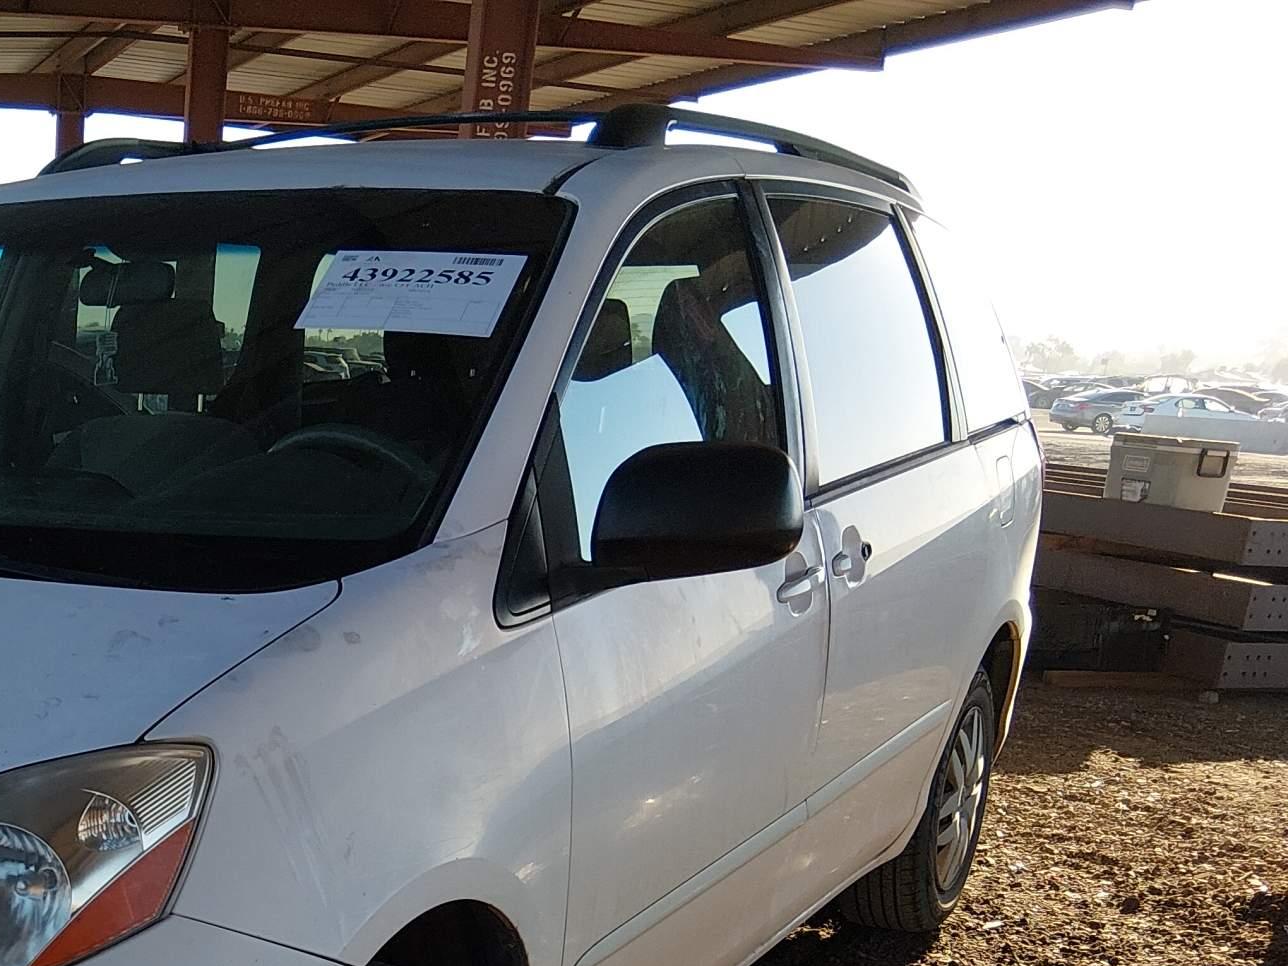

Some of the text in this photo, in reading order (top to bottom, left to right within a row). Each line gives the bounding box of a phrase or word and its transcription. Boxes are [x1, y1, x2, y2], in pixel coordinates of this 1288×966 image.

[476, 50, 500, 136] FB INC.
[342, 267, 495, 286] 43922585
